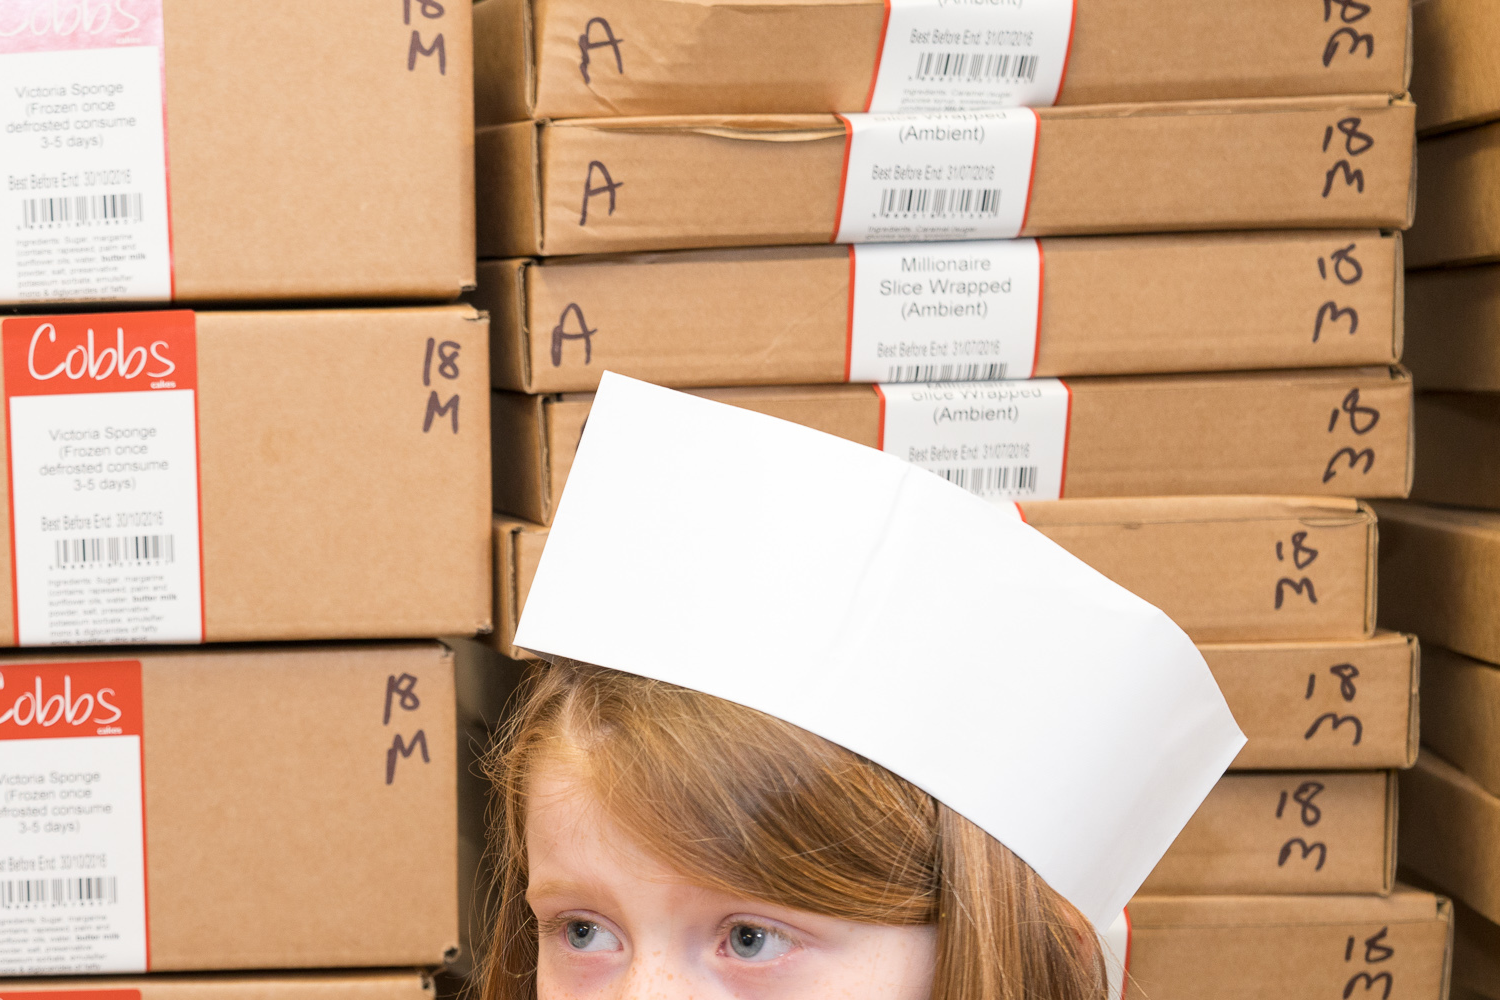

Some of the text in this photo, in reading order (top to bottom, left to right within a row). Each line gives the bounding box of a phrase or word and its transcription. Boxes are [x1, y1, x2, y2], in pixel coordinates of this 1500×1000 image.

[910, 29, 931, 45] Best
[932, 29, 961, 45] Before
[408, 29, 446, 76] M
[578, 17, 624, 84] A
[15, 83, 124, 99] Victoria Sponge
[26, 100, 115, 116] (Frozen once
[6, 116, 137, 134] defrosted consume
[41, 134, 104, 149] 3-5 days)
[899, 125, 985, 143] (Ambient)
[1322, 117, 1374, 156] 18
[872, 165, 892, 180] Best
[894, 165, 922, 181] Before
[9, 175, 28, 191] Best
[31, 174, 59, 190] Before
[579, 160, 624, 226] A
[901, 257, 991, 273] Millionaire
[880, 277, 1012, 297] Slice Wrapped
[901, 301, 988, 320] (Ambient)
[550, 302, 598, 367] A
[28, 323, 175, 380] Cobbs
[877, 341, 897, 358] Best
[899, 341, 927, 358] Before
[422, 337, 461, 387] 18
[150, 380, 176, 389] cakes
[422, 390, 460, 434] M
[933, 406, 1019, 425] (Ambient)
[1328, 387, 1380, 435] 18
[48, 426, 157, 441] Victoria Sponge
[59, 443, 148, 460] (Frozen once
[909, 447, 928, 462] Best
[931, 445, 958, 462] Before
[39, 459, 169, 476] defrosted consume
[74, 477, 136, 492] 3-5 days)
[41, 516, 61, 532] Best
[63, 515, 91, 531] Before
[1276, 531, 1319, 569] 18
[1305, 663, 1360, 702] 18
[383, 672, 420, 725] 18
[96, 726, 122, 735] cakes
[385, 729, 430, 785] M
[49, 771, 101, 785] Sponge
[5, 788, 92, 803] (Frozen once
[1276, 781, 1325, 827] 18
[51, 804, 113, 816] consume
[19, 821, 80, 834] 3-5 days)
